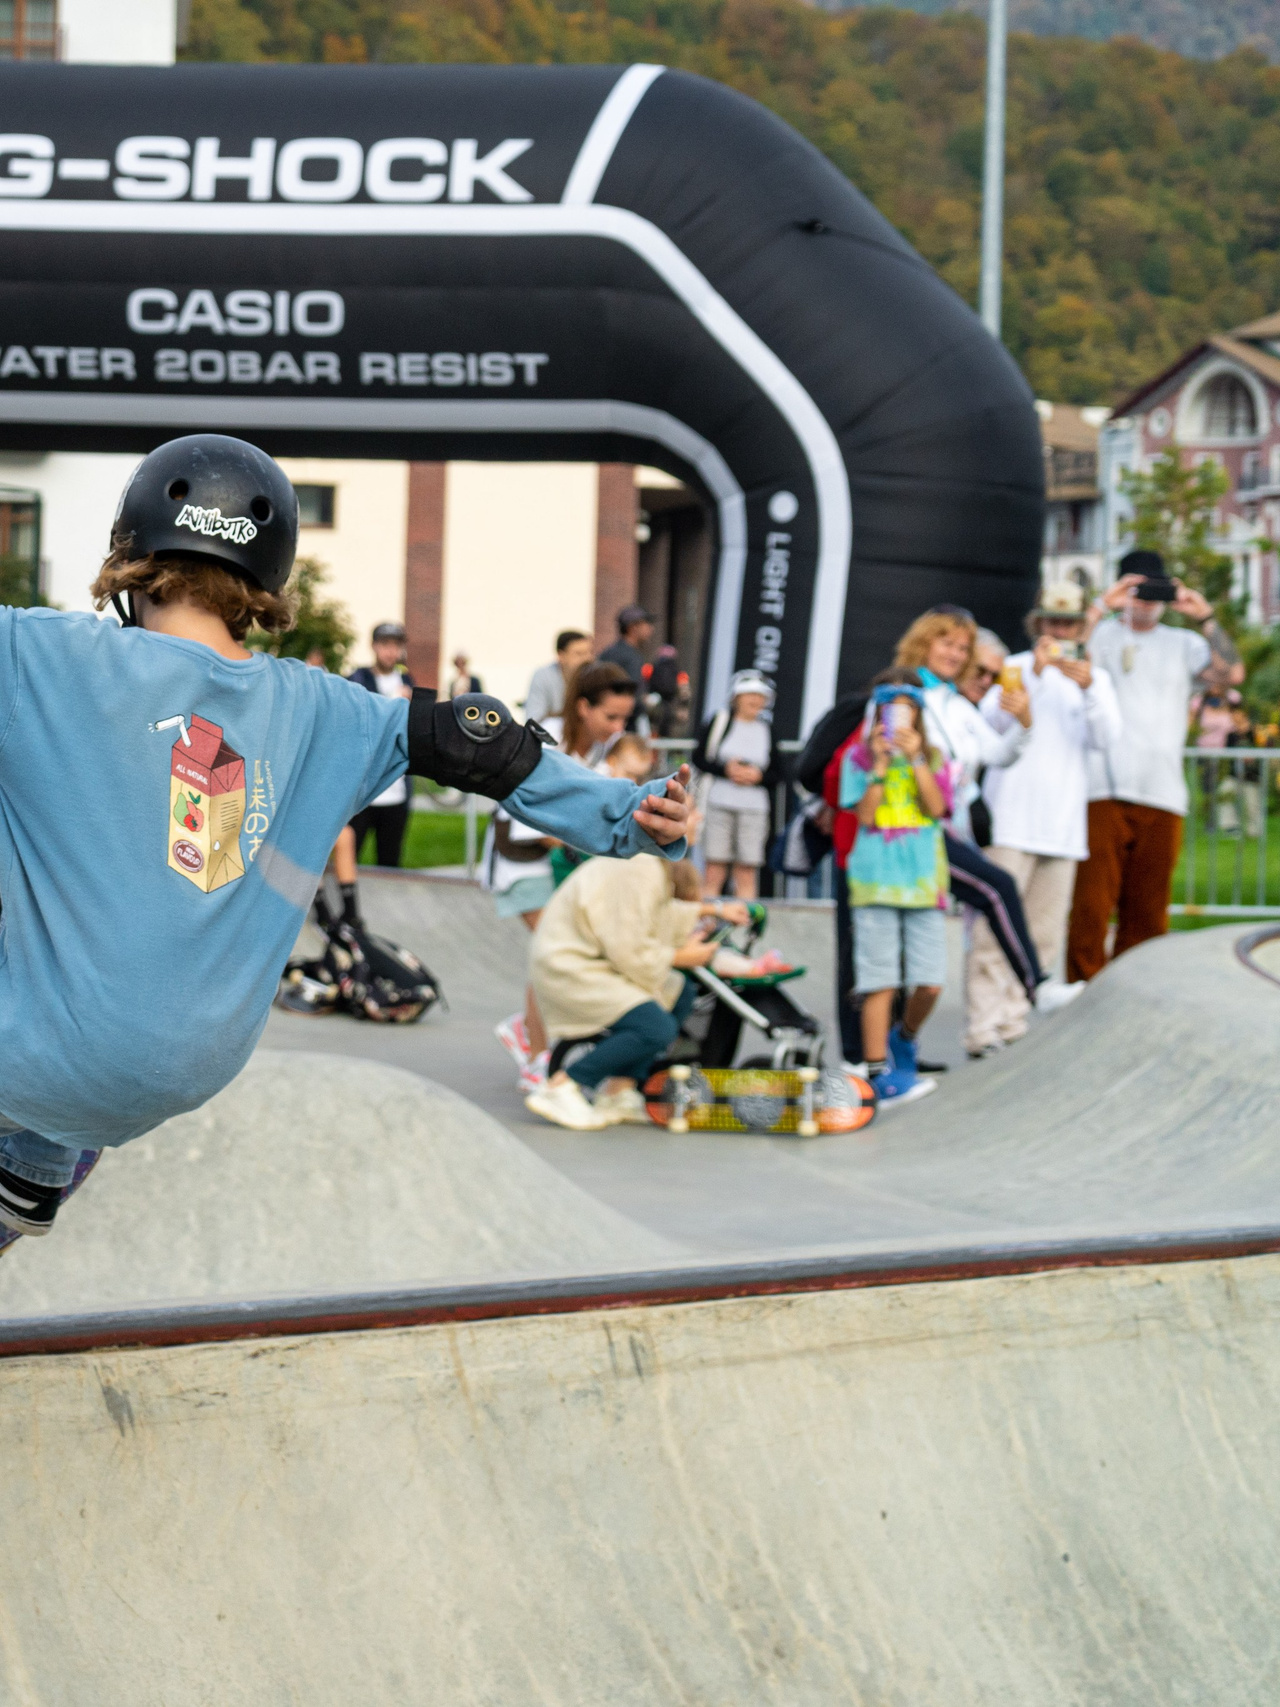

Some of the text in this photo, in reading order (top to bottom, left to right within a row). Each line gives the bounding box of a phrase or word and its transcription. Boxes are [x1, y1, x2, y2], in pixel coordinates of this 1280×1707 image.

[127, 288, 345, 337] CASIO
[155, 348, 342, 384] 20BAR
[360, 353, 549, 387] RESIST
[753, 532, 792, 672] LIGHT ON
[175, 763, 186, 775] ALL
